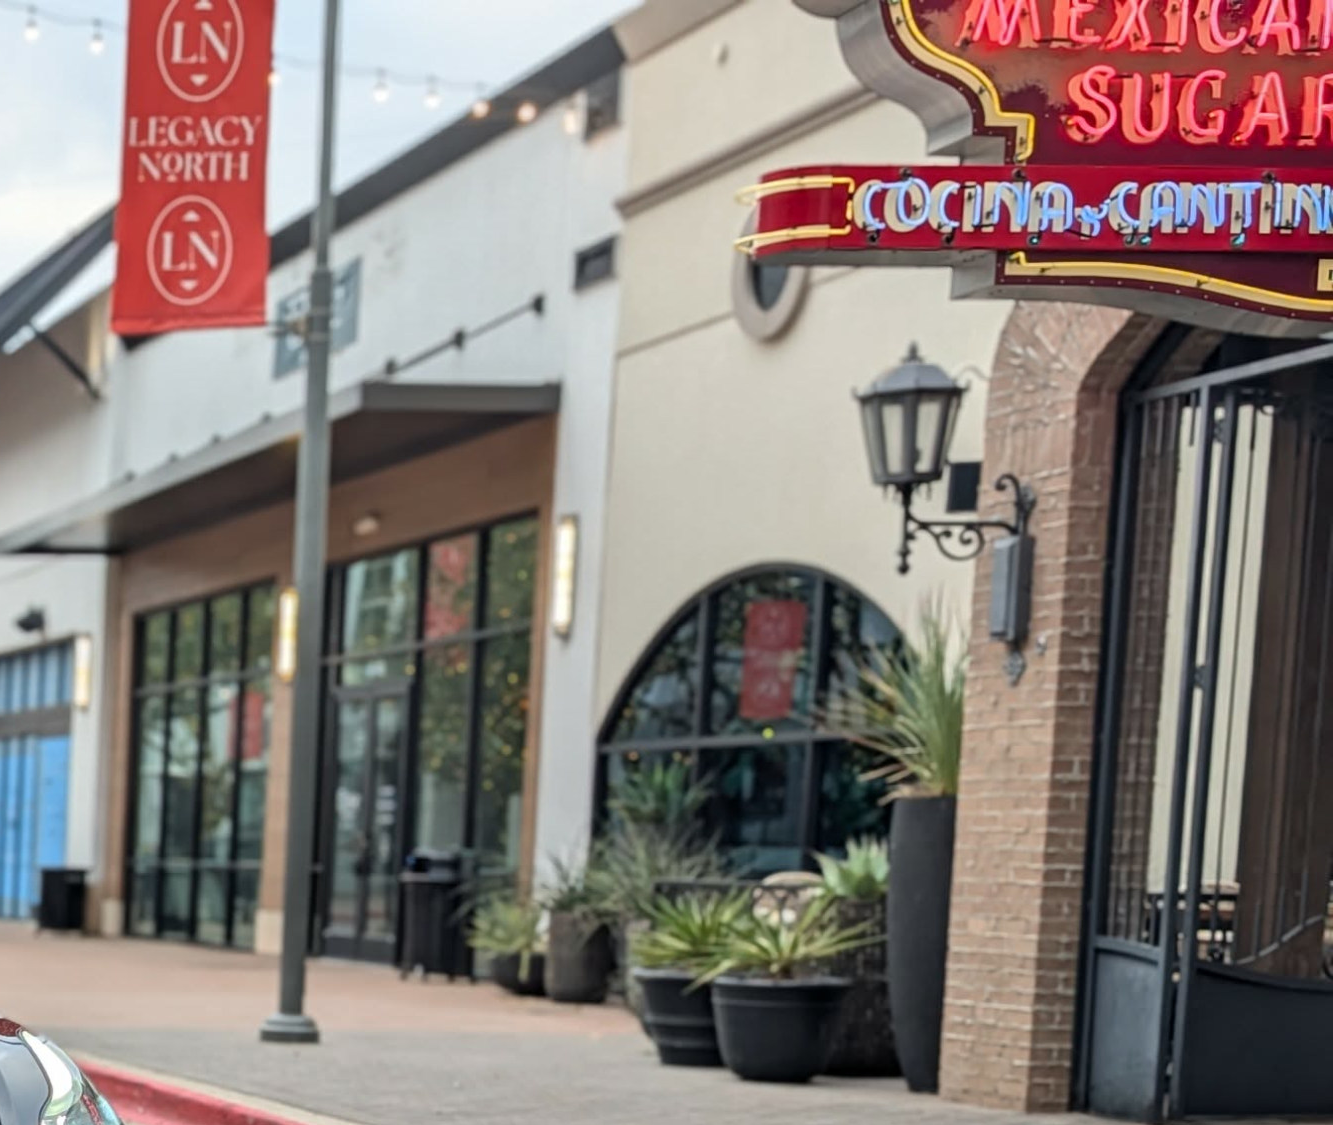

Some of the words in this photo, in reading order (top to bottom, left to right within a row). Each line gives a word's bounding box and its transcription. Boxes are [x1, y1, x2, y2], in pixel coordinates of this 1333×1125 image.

[171, 21, 232, 64] LN
[128, 114, 262, 147] LEGACY
[137, 151, 249, 183] NORTH
[853, 178, 1073, 235] COCINA
[1107, 179, 1333, 235] CANTIN
[161, 231, 219, 271] LN
